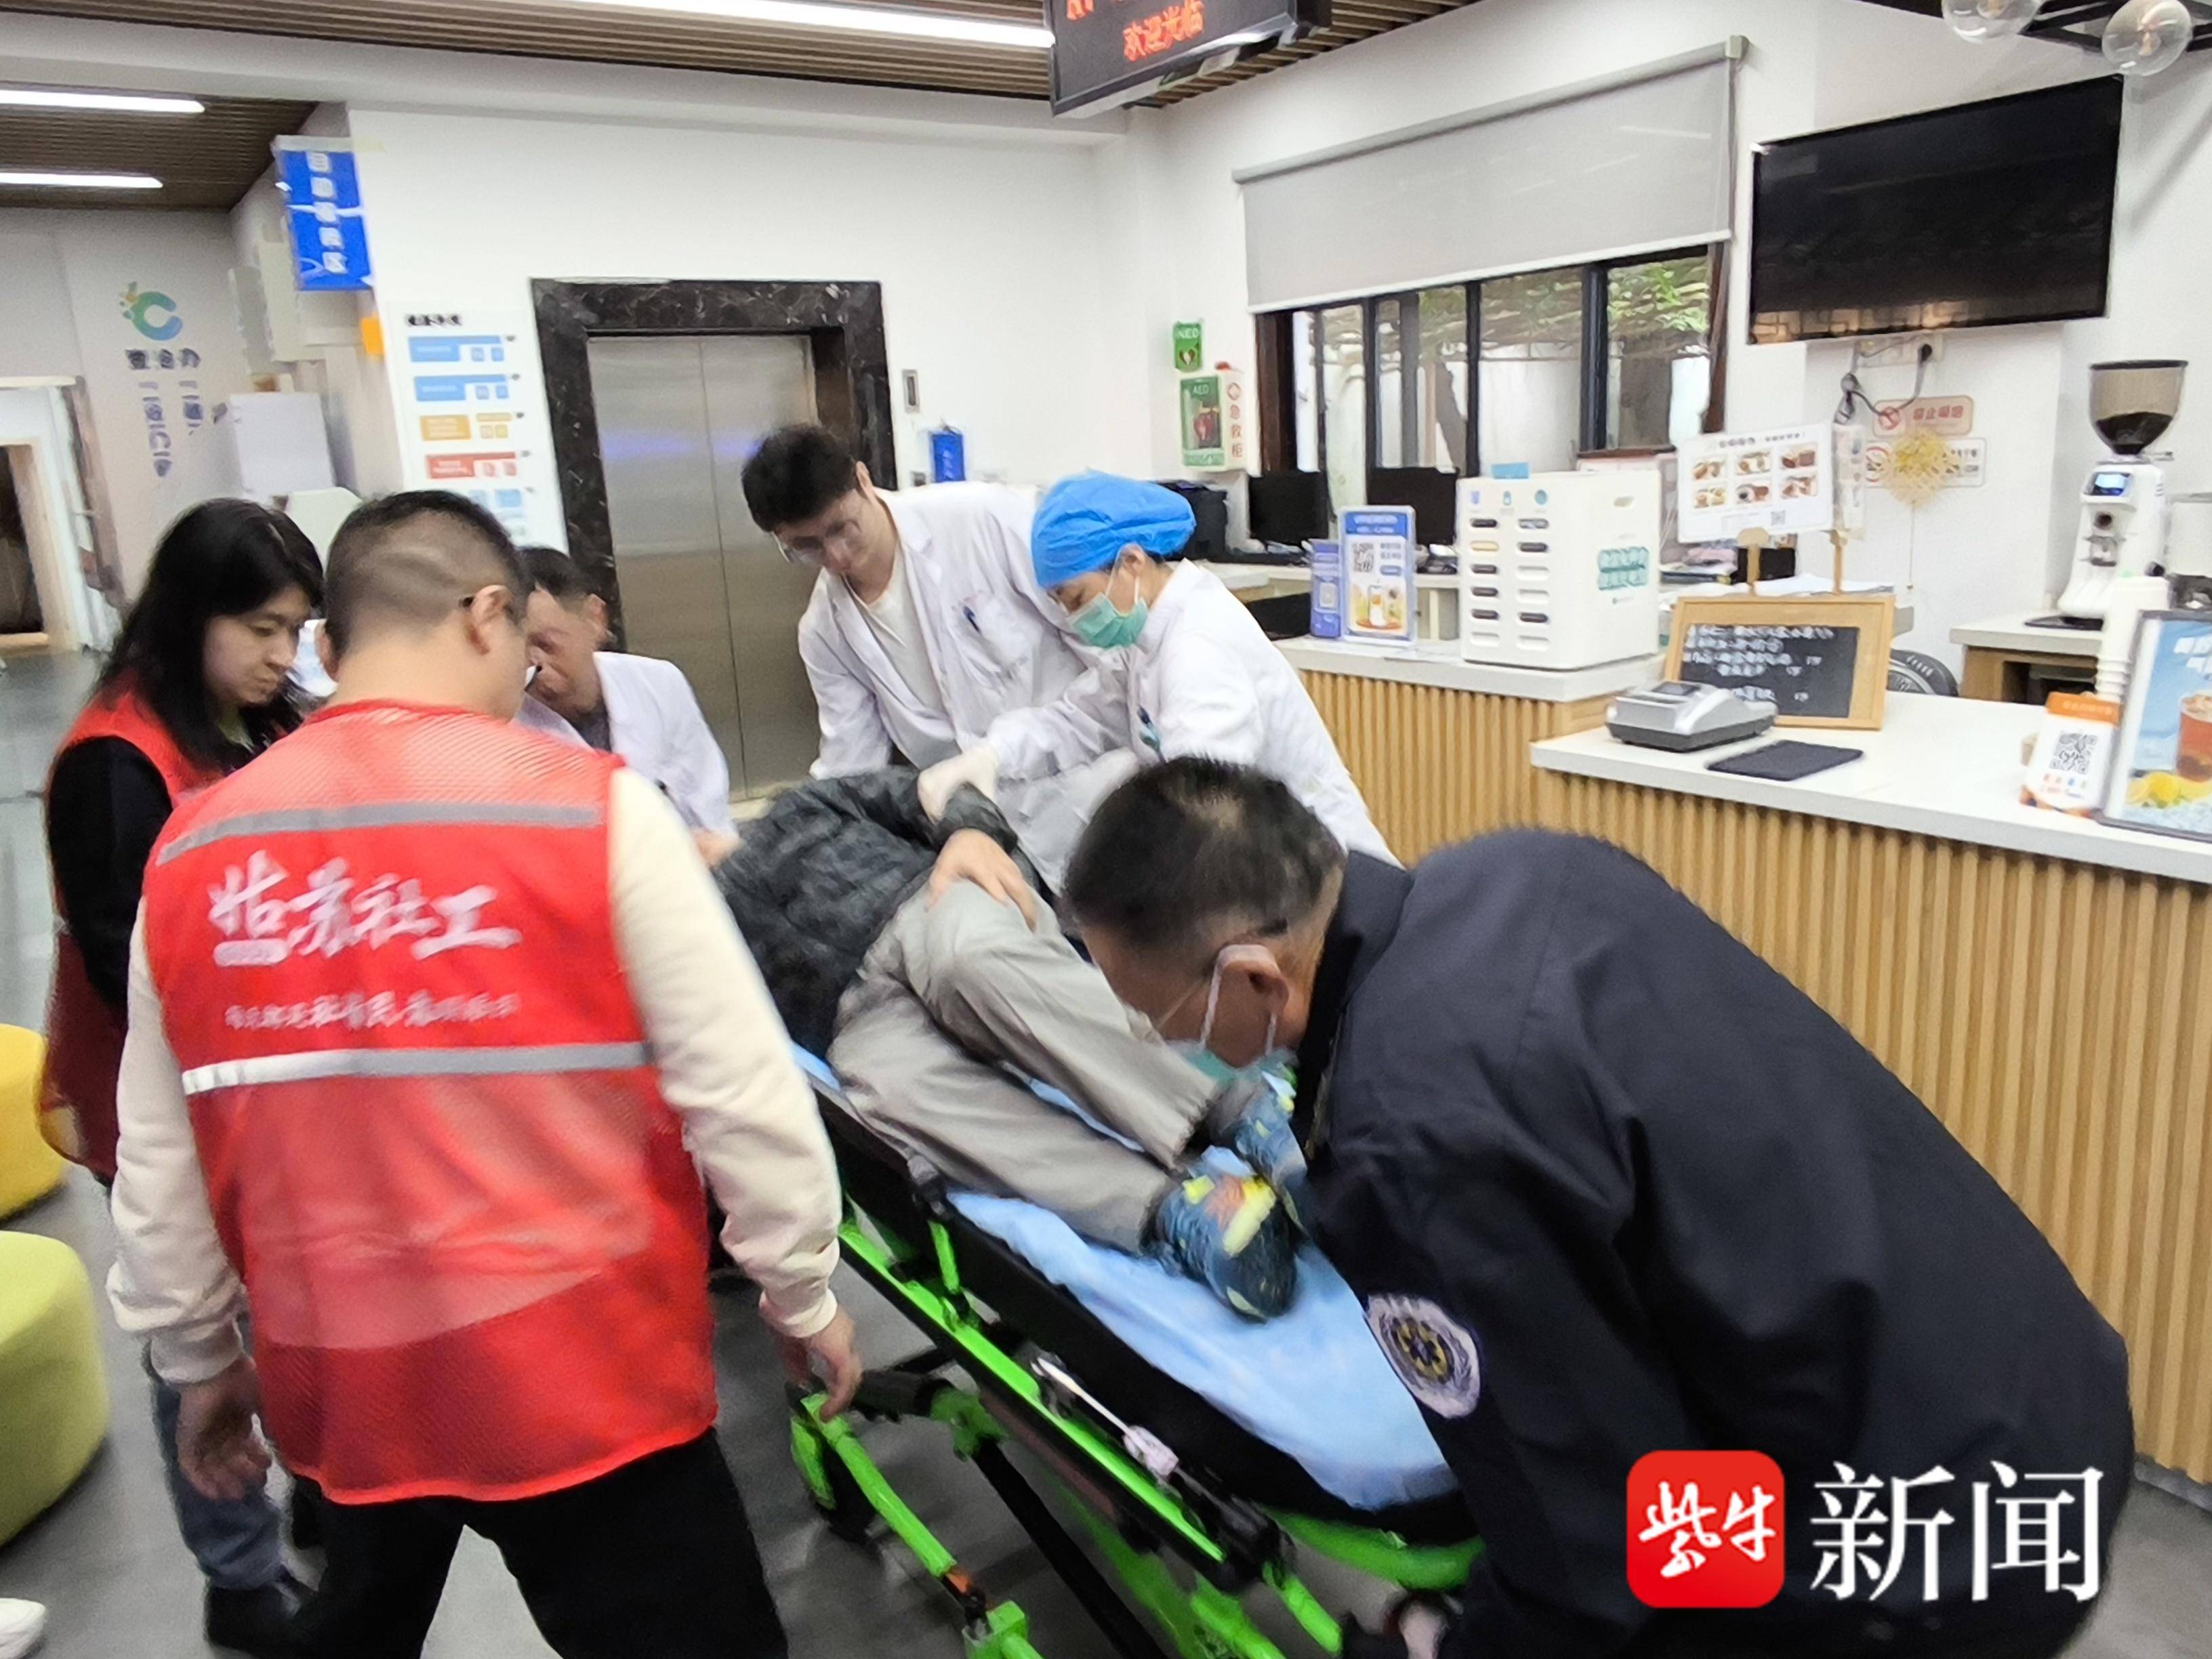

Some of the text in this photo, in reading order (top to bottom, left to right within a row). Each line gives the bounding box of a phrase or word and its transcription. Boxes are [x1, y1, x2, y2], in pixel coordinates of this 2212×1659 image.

[1123, 0, 1204, 61] 欢迎光临
[1193, 384, 1209, 395] AED
